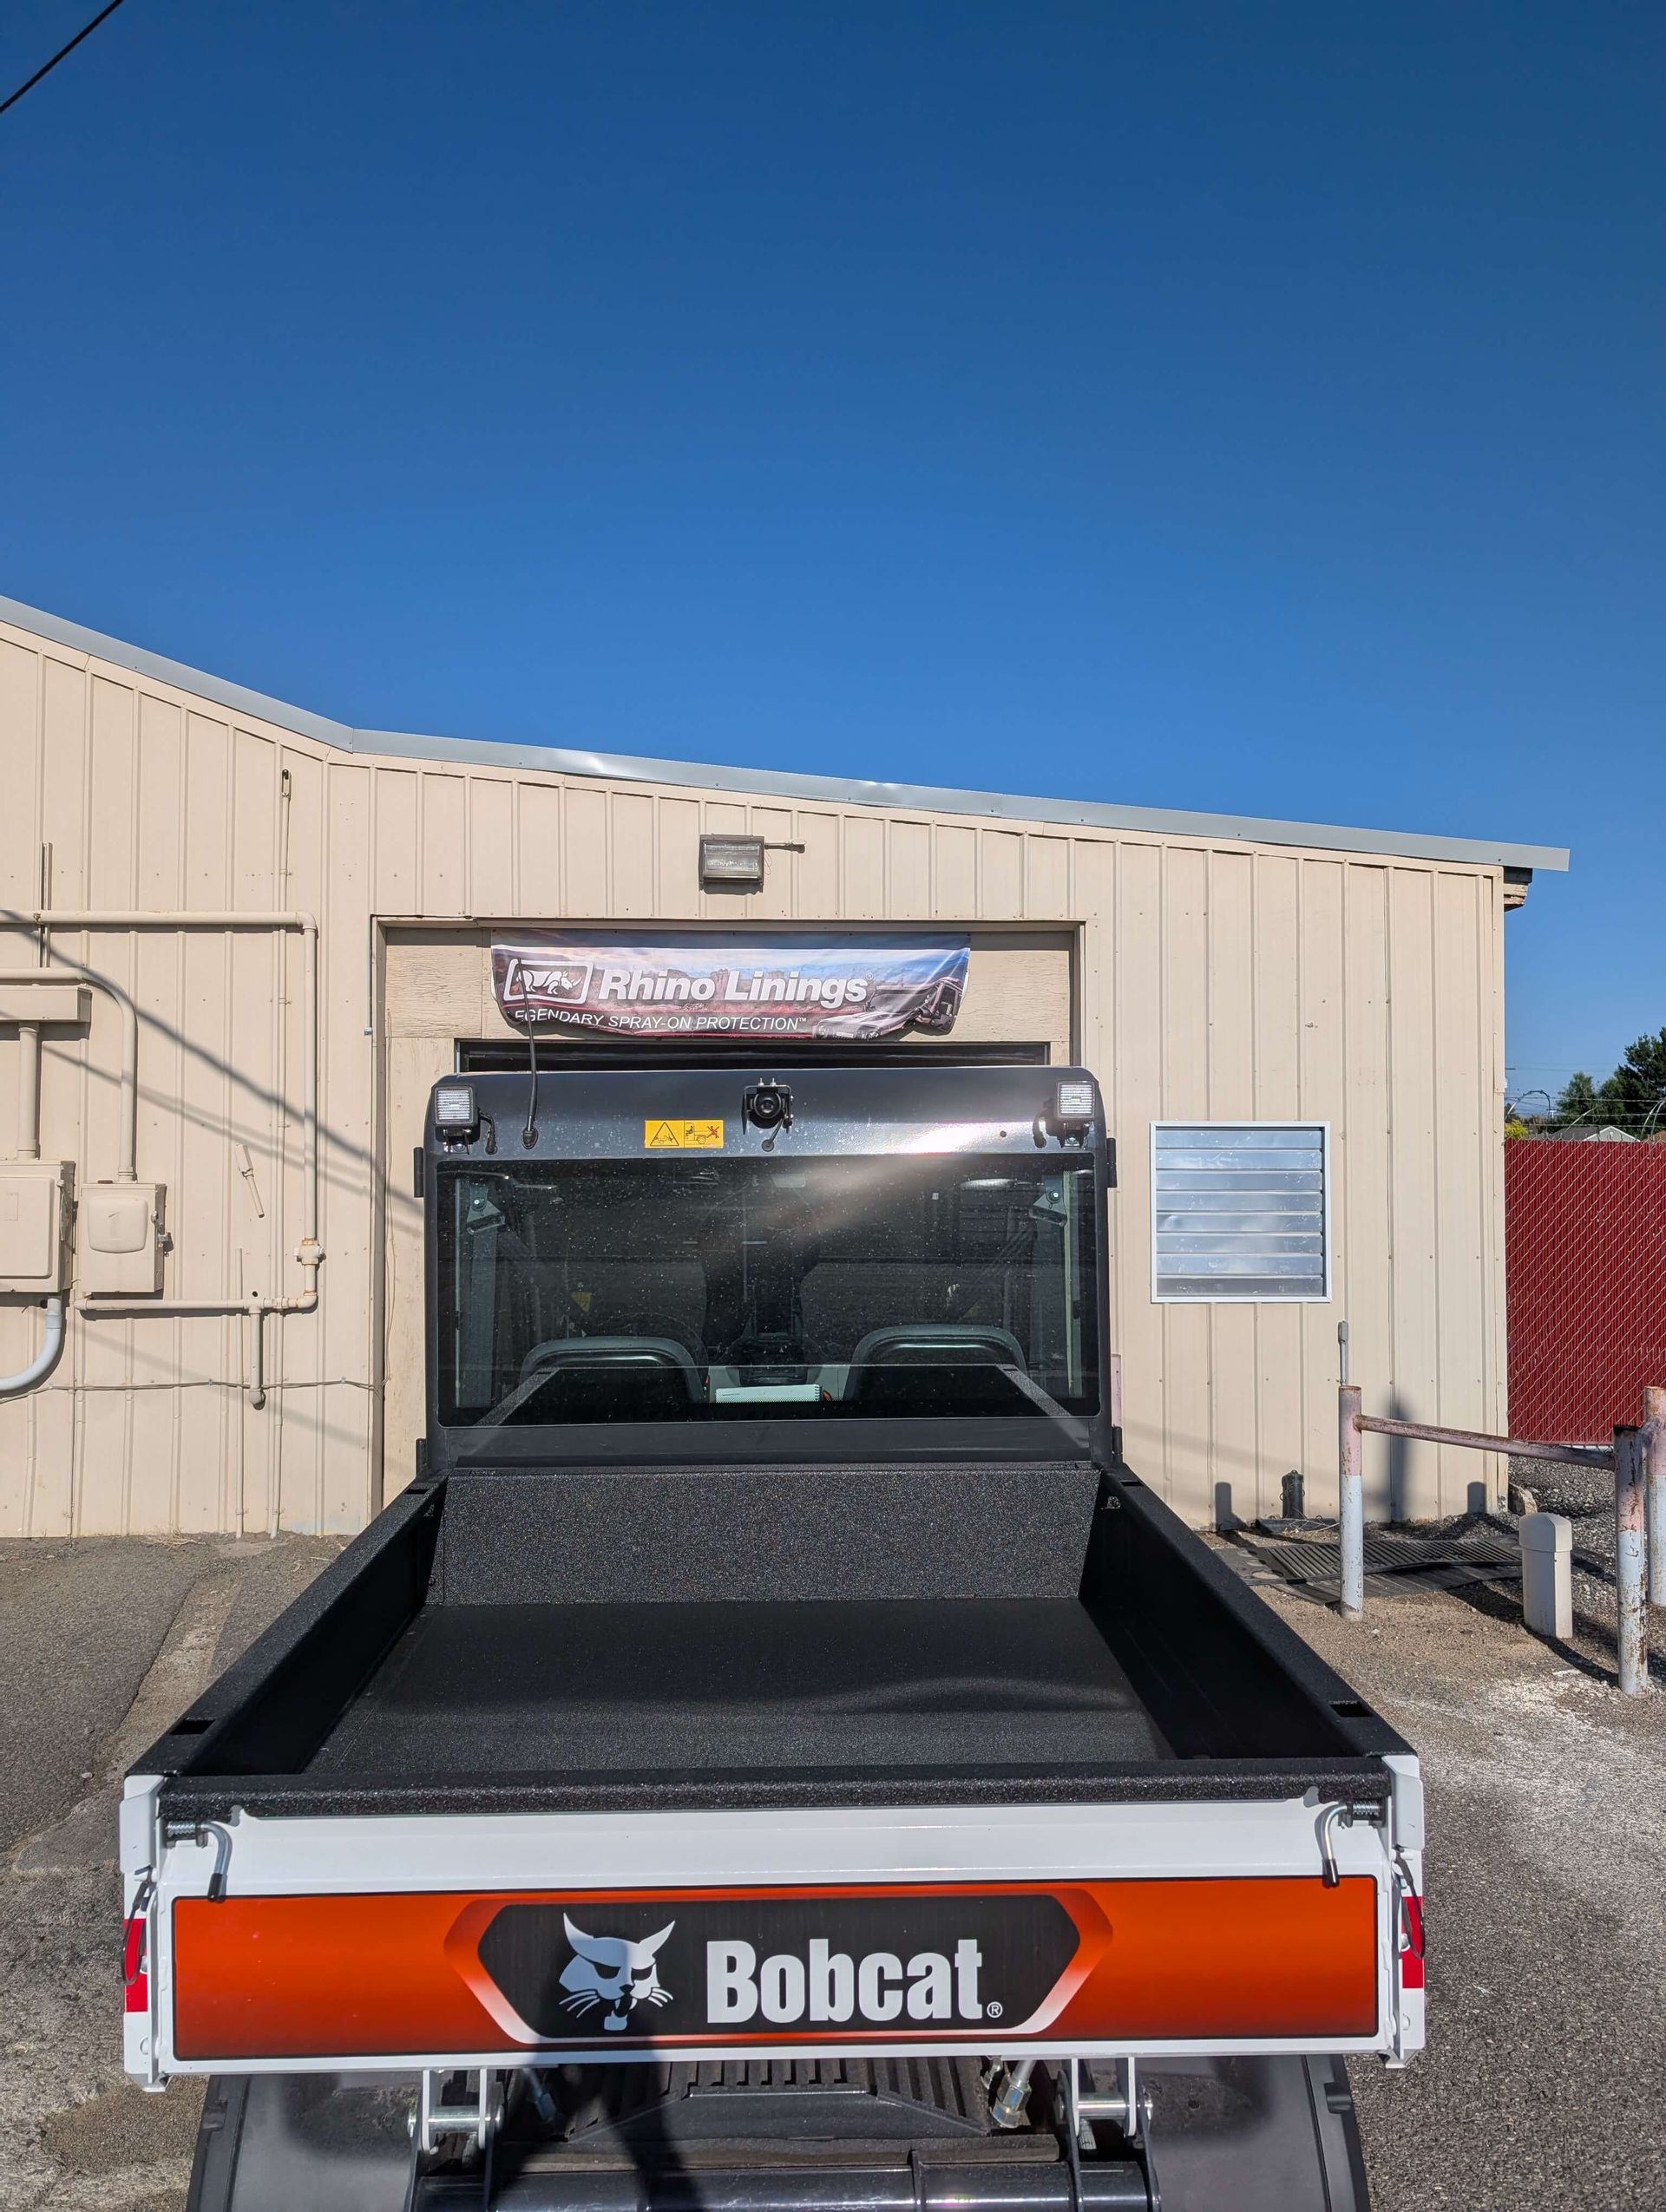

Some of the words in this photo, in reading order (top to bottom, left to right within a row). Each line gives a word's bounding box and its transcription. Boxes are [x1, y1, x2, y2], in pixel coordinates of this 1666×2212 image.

[598, 969, 715, 1001] Rhino
[508, 1009, 604, 1026] EGENDARY
[608, 1016, 692, 1030] SPRAY-ON
